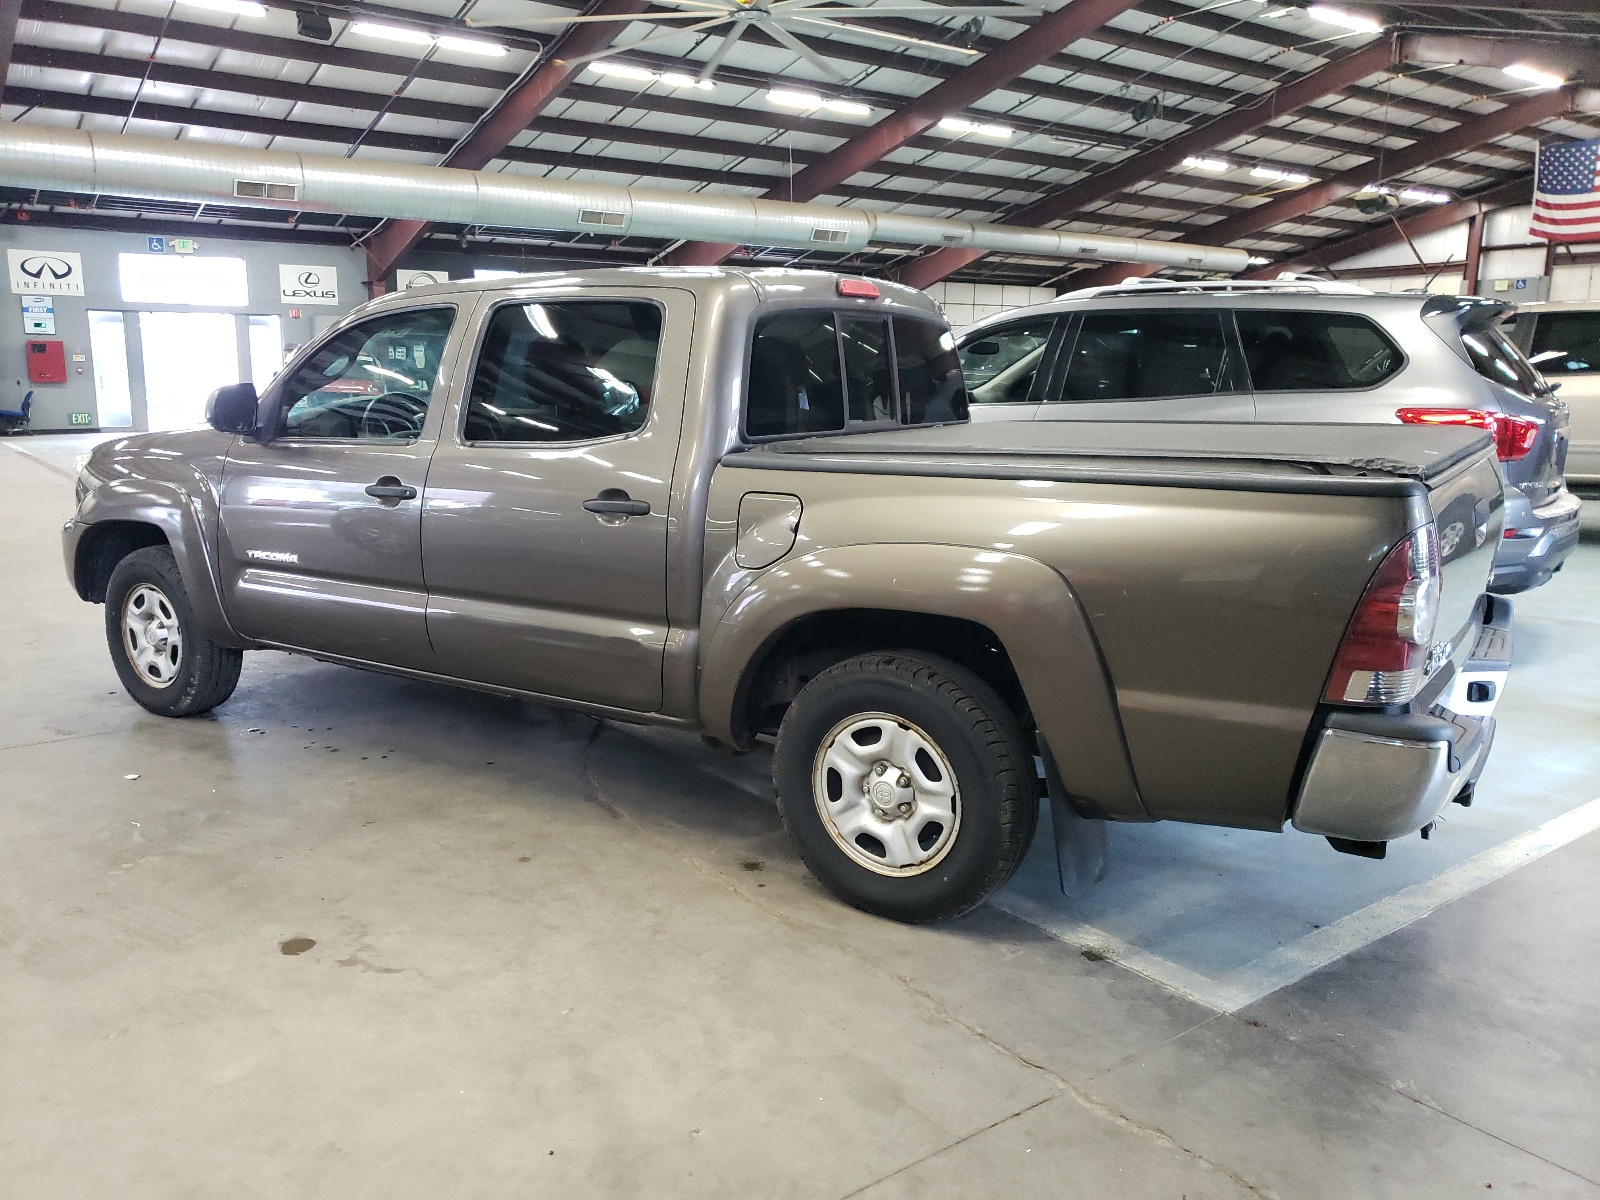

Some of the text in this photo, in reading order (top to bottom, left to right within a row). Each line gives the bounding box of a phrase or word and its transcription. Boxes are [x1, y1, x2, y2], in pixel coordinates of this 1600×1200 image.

[16, 281, 79, 290] INFINITI
[283, 289, 336, 299] LEXUS
[28, 306, 48, 314] FIRST
[72, 413, 89, 424] EXIT
[246, 549, 298, 564] TACOMA
